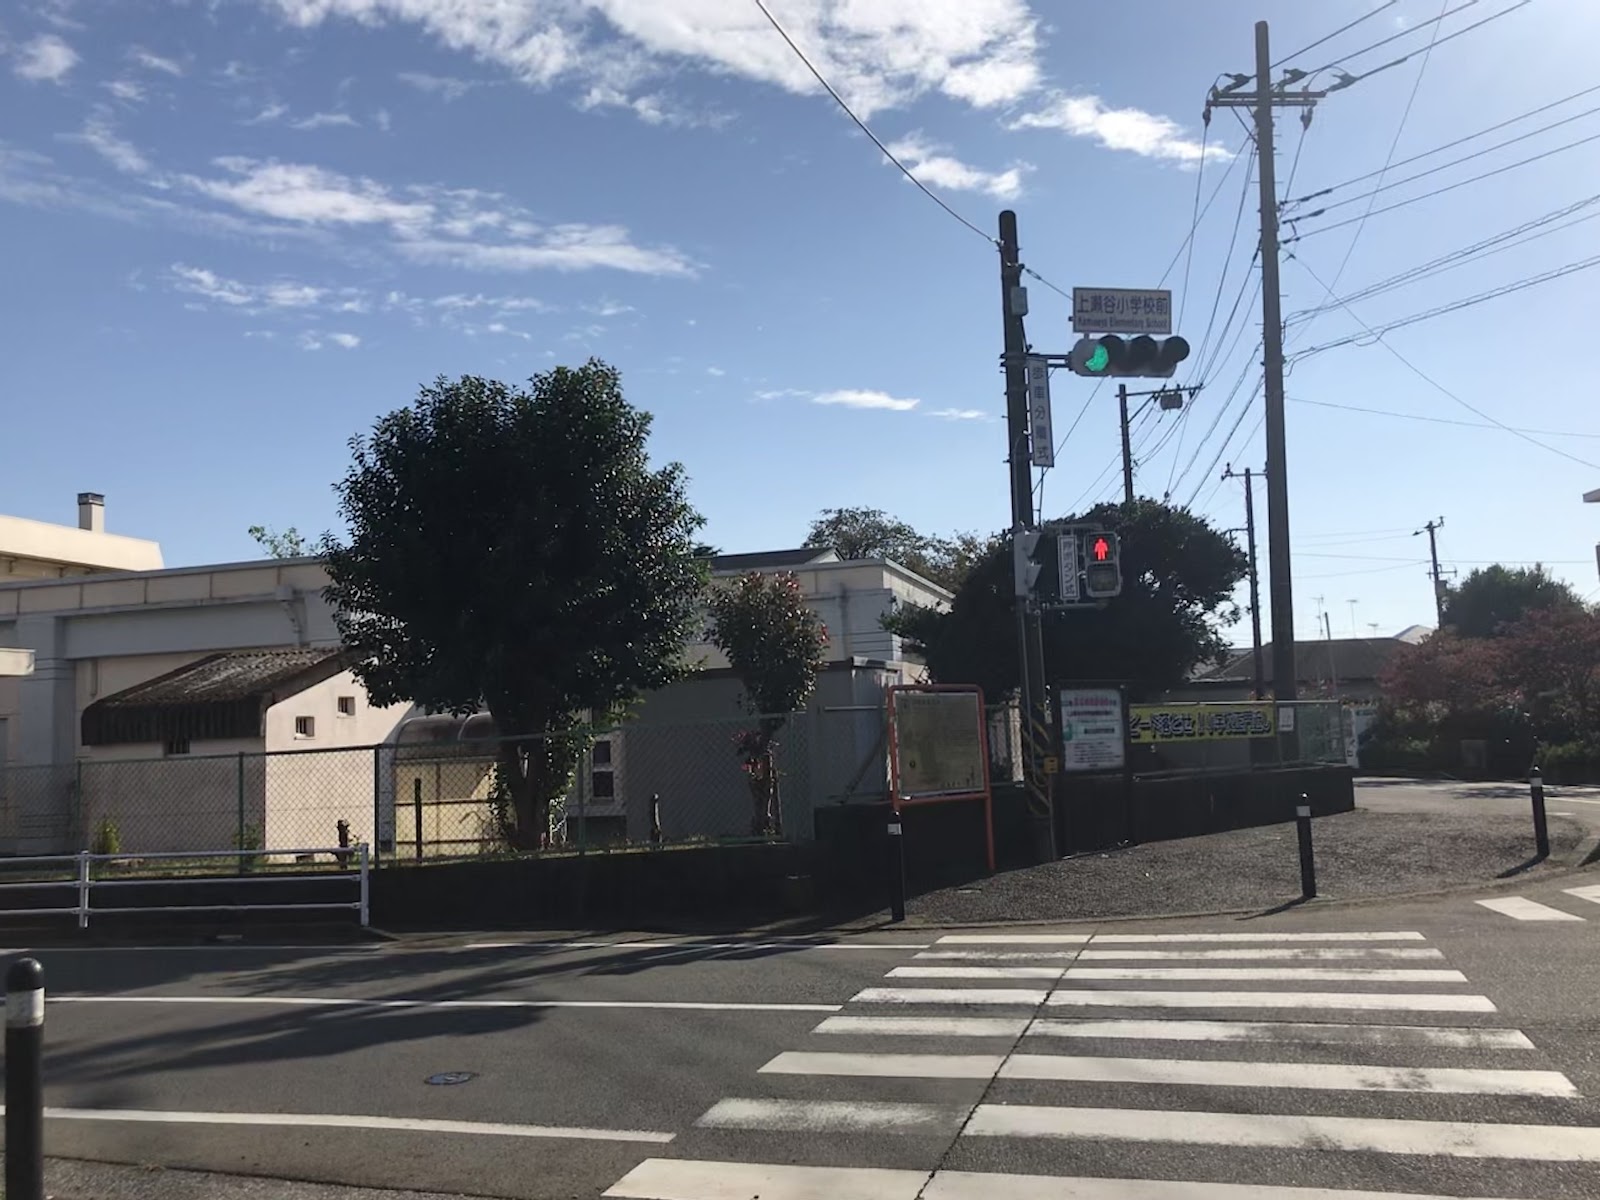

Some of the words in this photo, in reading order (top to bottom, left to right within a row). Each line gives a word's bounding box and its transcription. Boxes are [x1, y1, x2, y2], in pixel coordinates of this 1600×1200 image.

[1077, 295, 1168, 315] 上瀬谷小学校前
[1146, 317, 1168, 329] School
